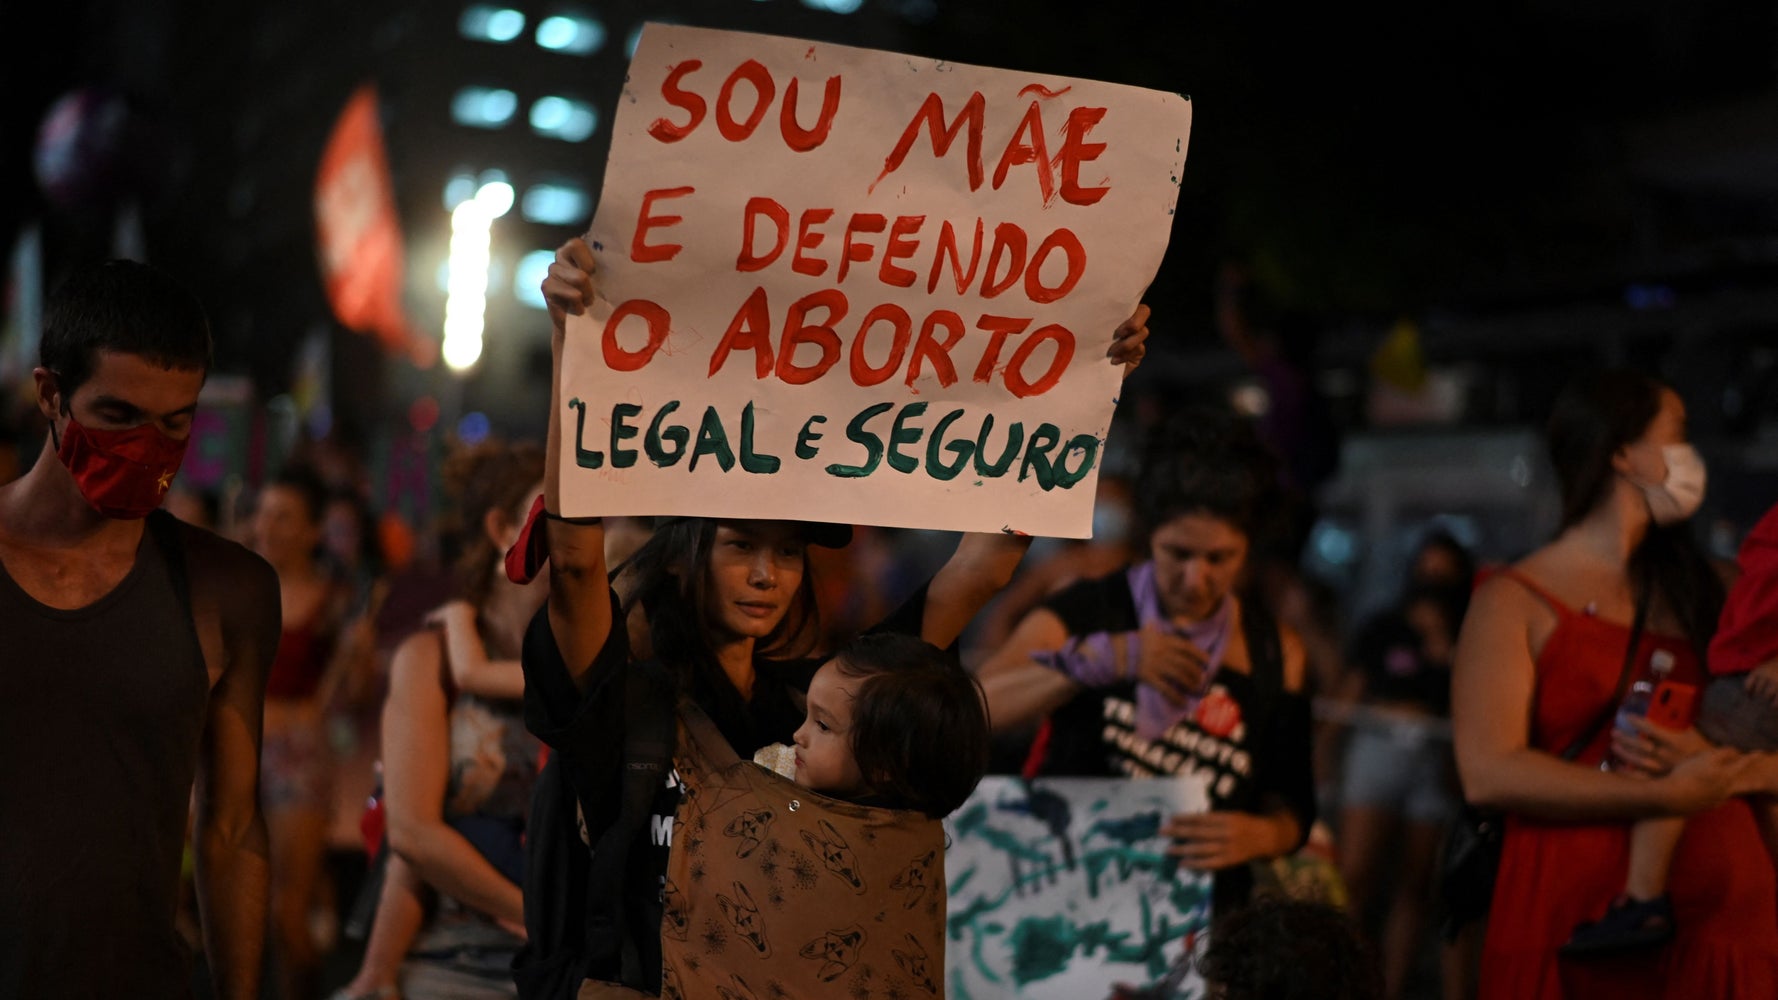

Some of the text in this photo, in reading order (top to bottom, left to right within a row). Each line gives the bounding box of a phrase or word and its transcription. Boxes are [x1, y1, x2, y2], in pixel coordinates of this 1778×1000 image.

[648, 58, 1111, 209] SOU MÃE
[630, 185, 1088, 305] E DEFENDO
[600, 286, 1077, 399] O ABORTO
[568, 396, 781, 474] LEGAL
[825, 400, 1103, 492] SEGURO
